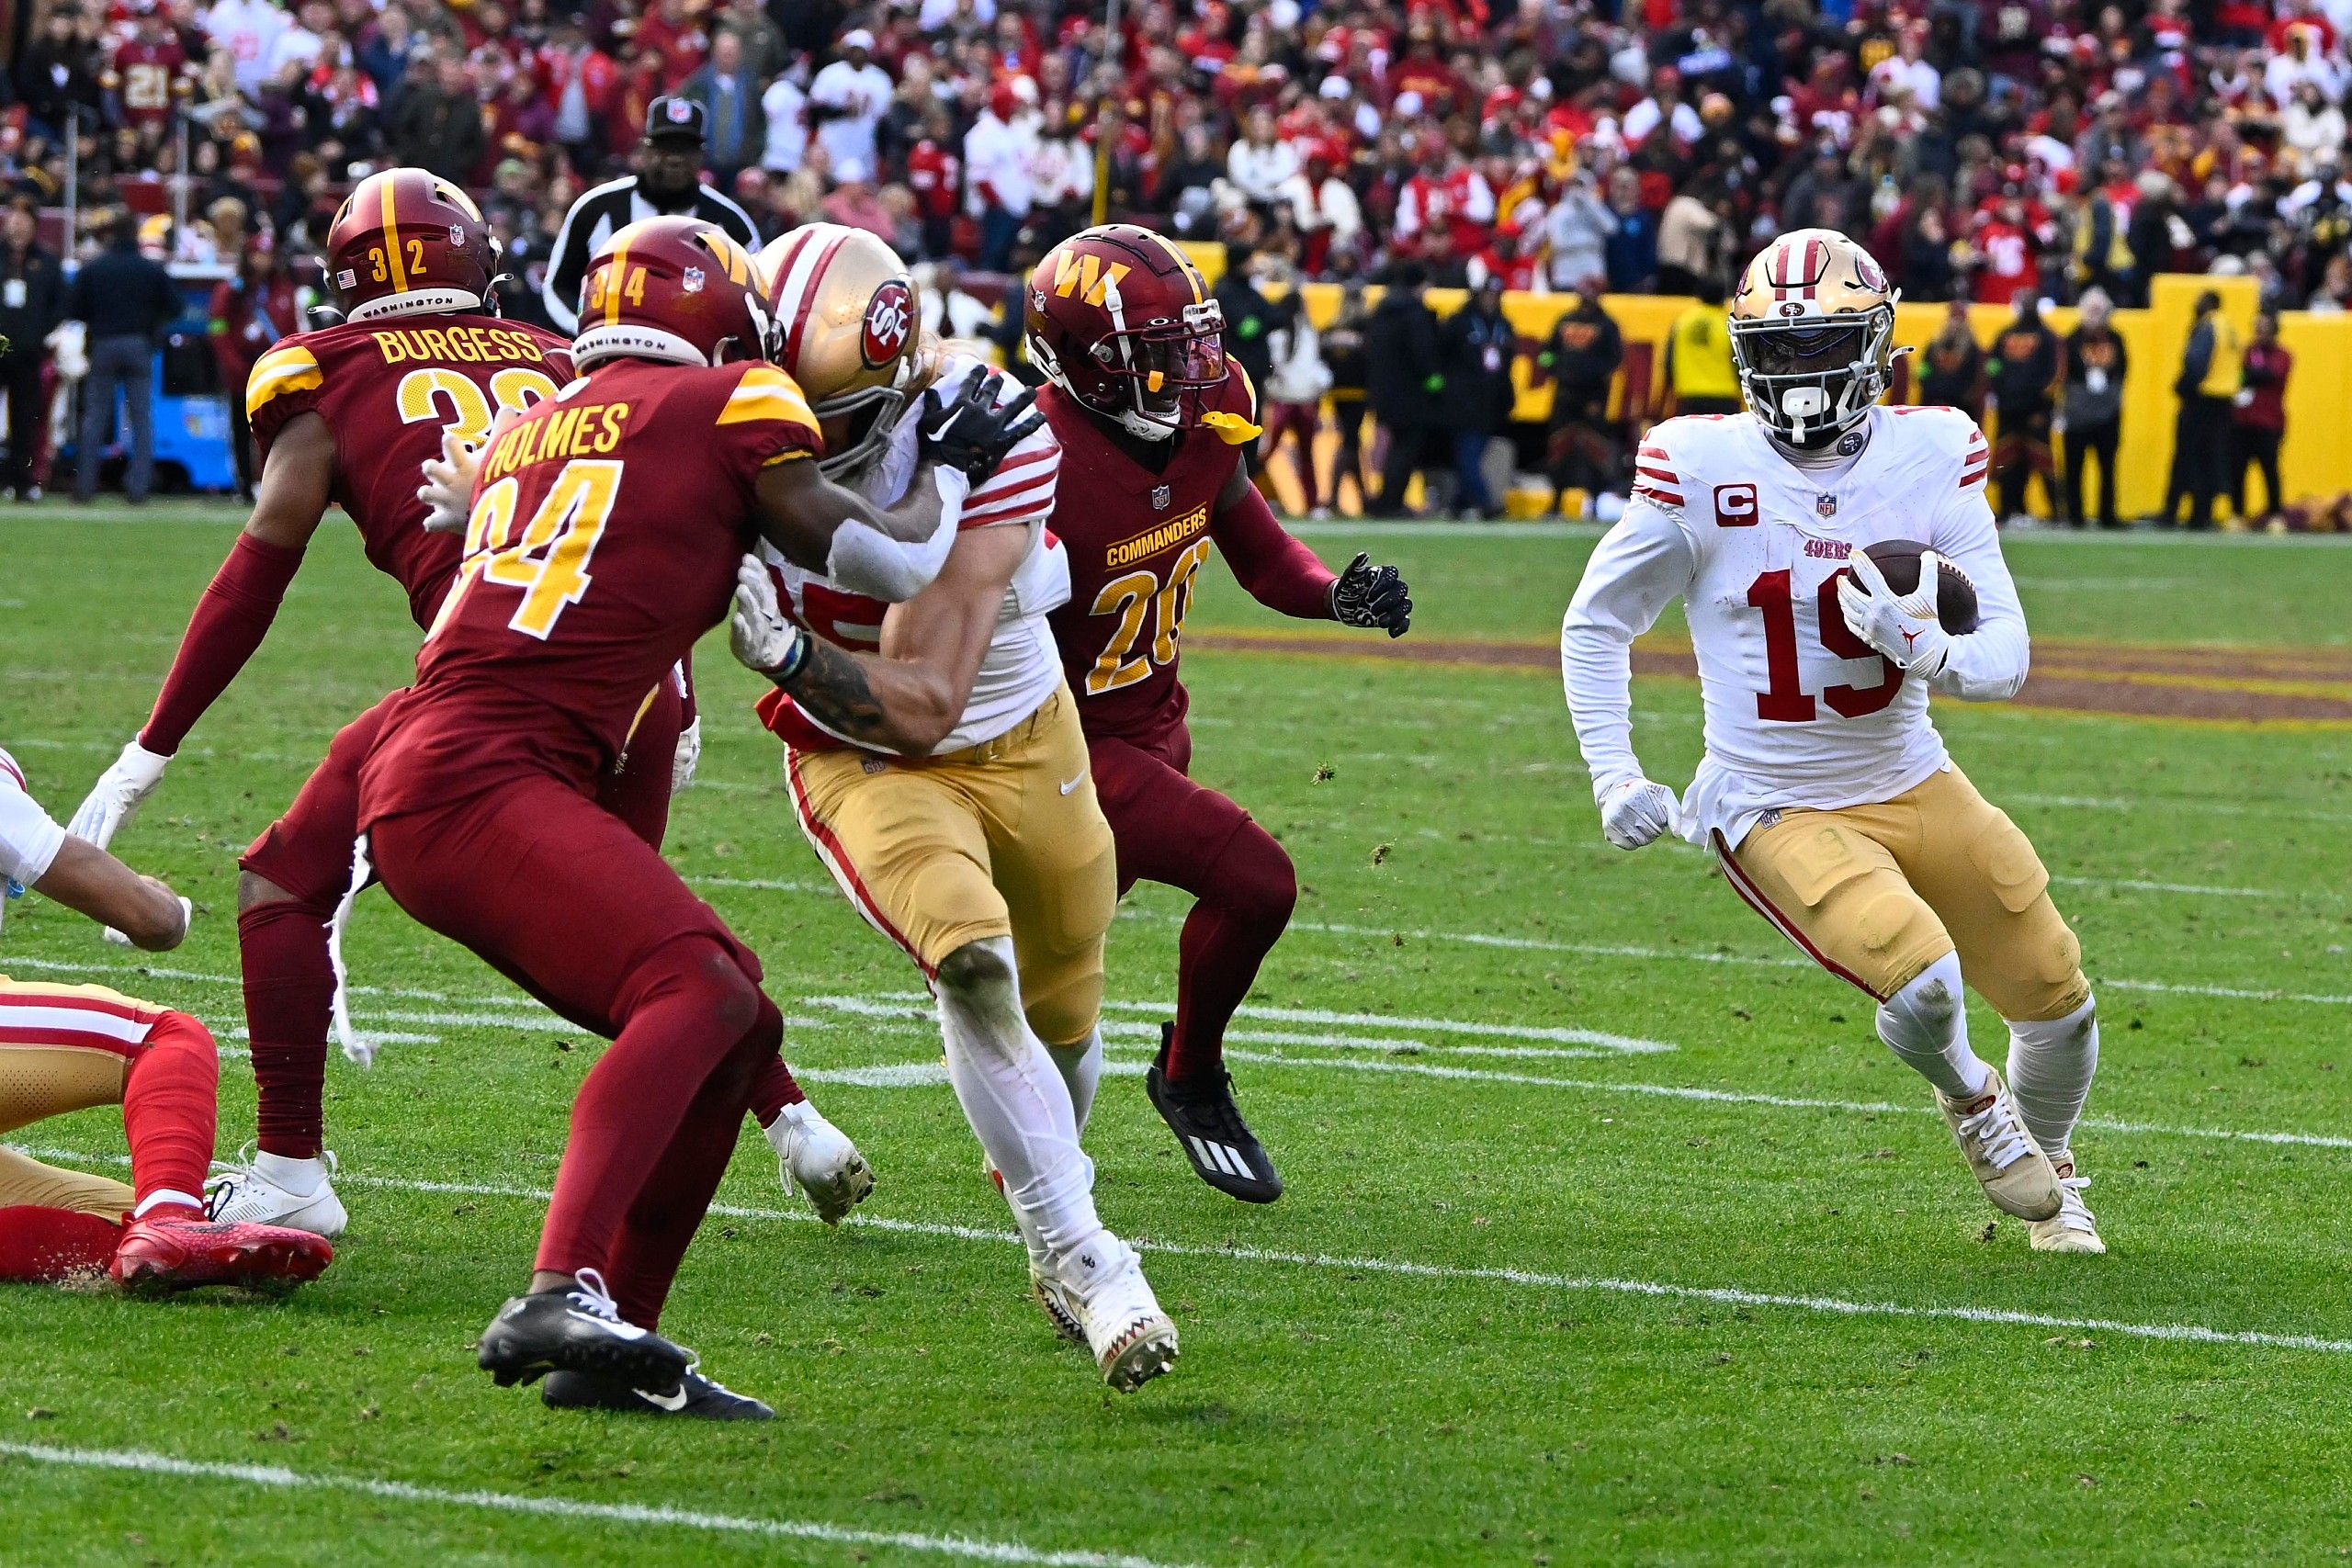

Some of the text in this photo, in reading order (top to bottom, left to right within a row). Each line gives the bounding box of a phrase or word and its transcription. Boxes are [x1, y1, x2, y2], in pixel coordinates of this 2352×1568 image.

[363, 298, 453, 318] WASHINGTON
[370, 326, 543, 364] BURGESS
[576, 337, 665, 354] WASHINGTON
[484, 402, 628, 482] HOLMES
[1718, 487, 1754, 515] C
[1106, 508, 1207, 567] COMMANDERS
[1804, 538, 1853, 560] 49ERS
[1747, 568, 1905, 722] 19
